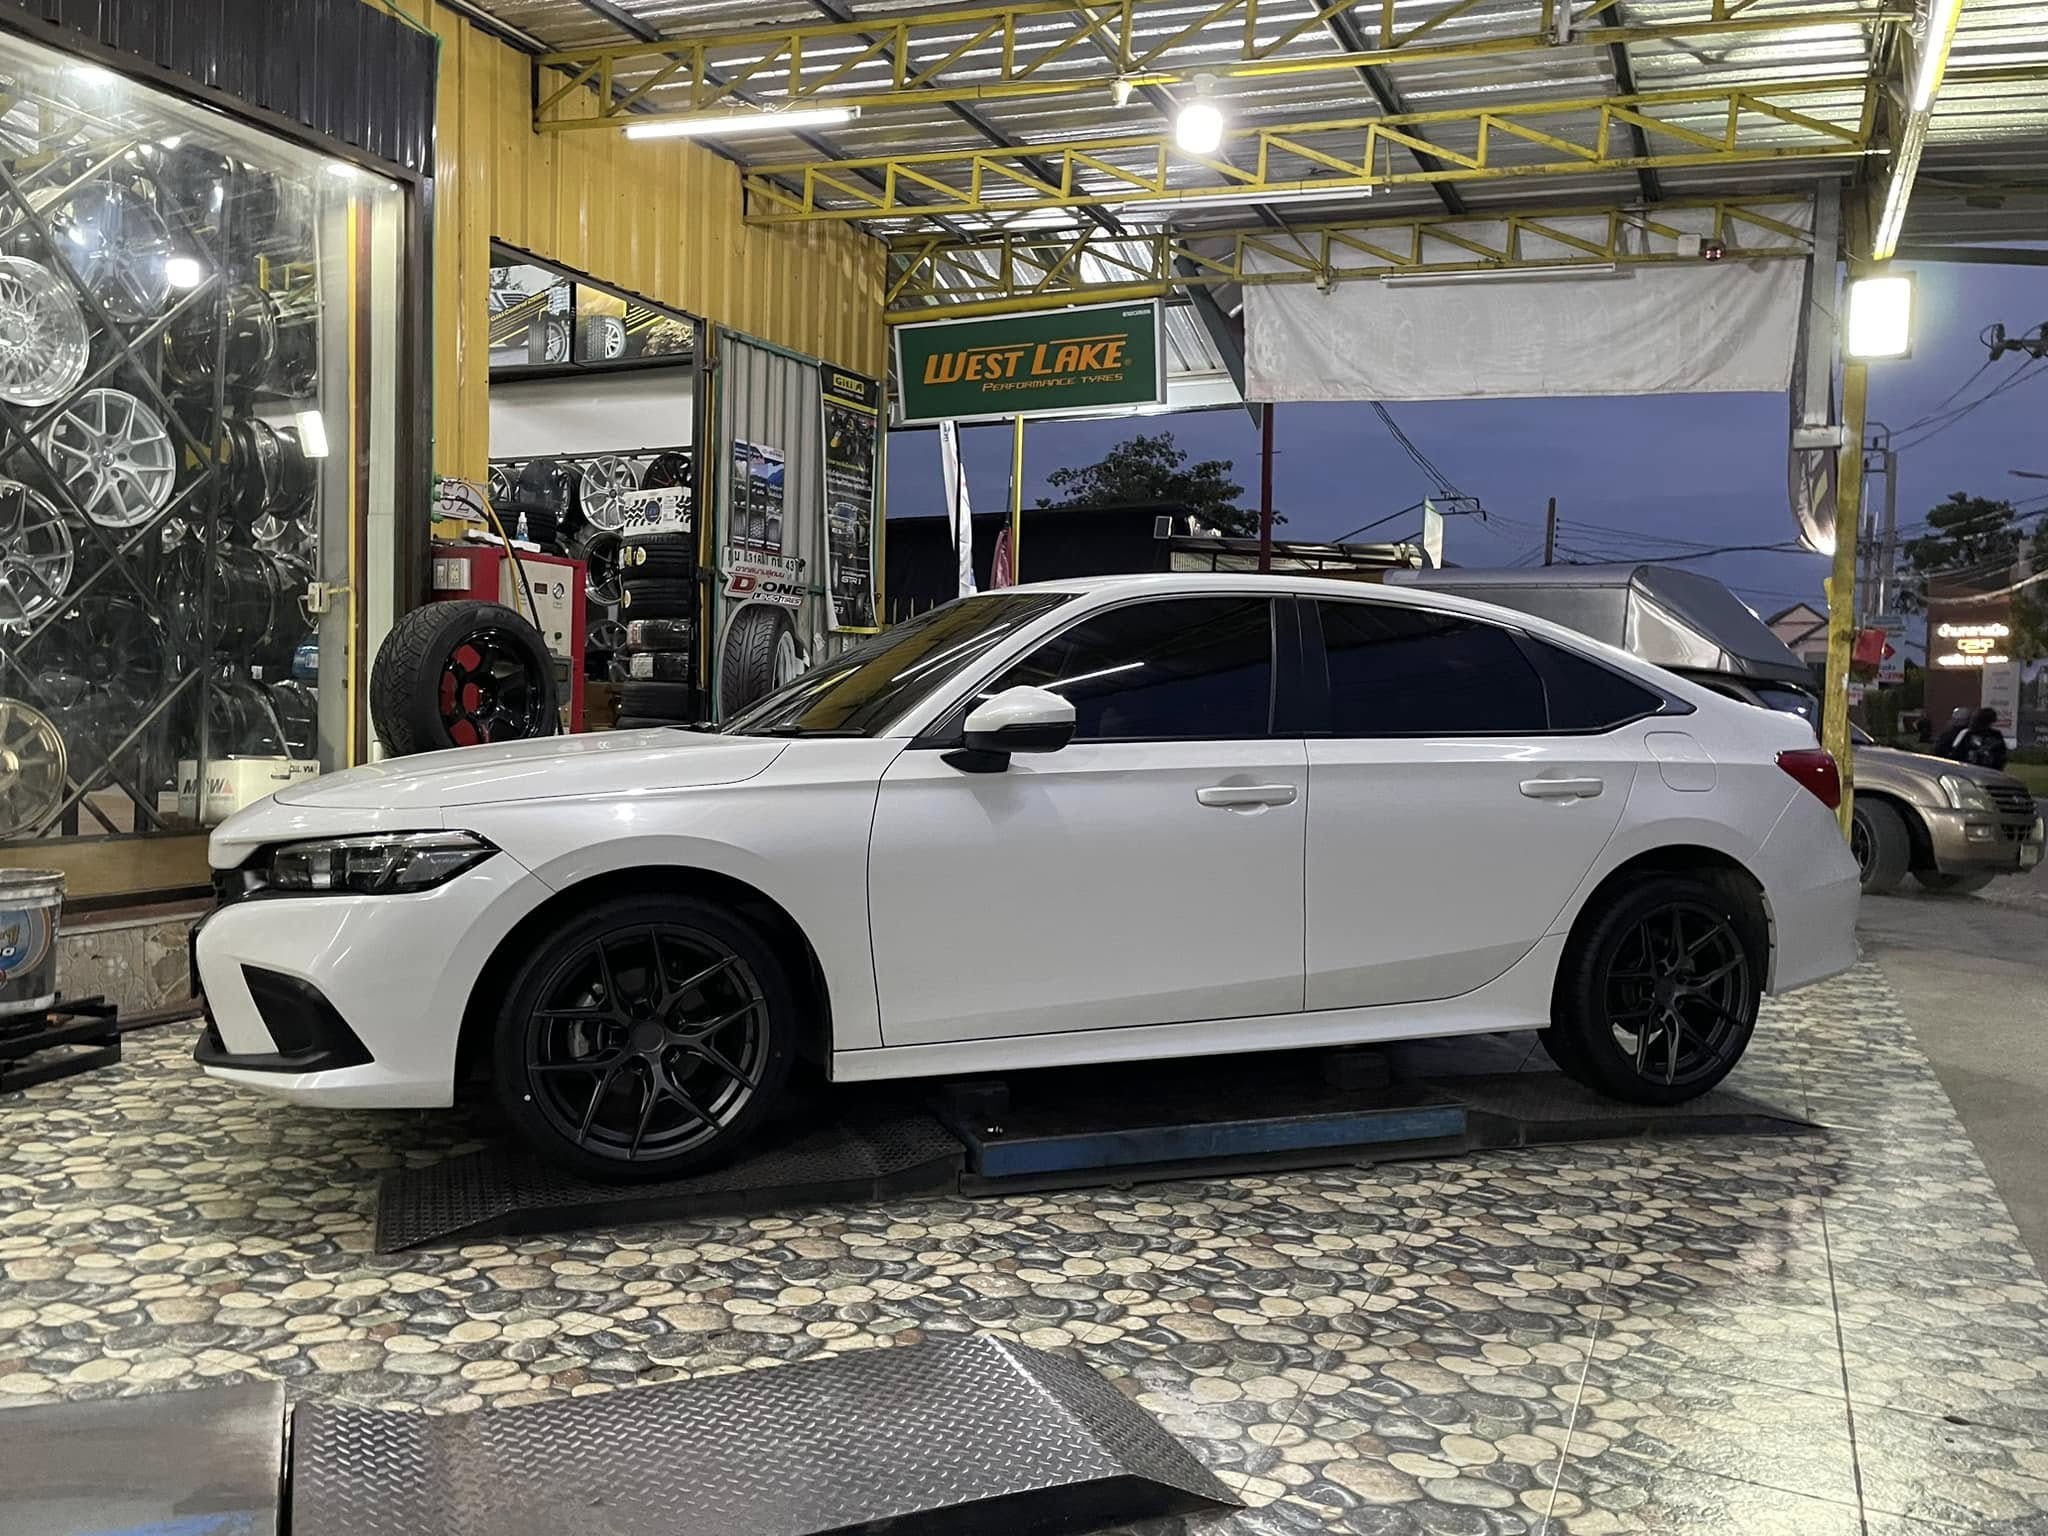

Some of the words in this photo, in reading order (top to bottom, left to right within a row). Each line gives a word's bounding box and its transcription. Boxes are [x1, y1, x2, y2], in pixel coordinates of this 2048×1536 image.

[923, 351, 1025, 384] WEST
[1031, 341, 1126, 375] LAKE
[982, 376, 1075, 392] PERFORMANCE
[1081, 373, 1123, 385] TYRES
